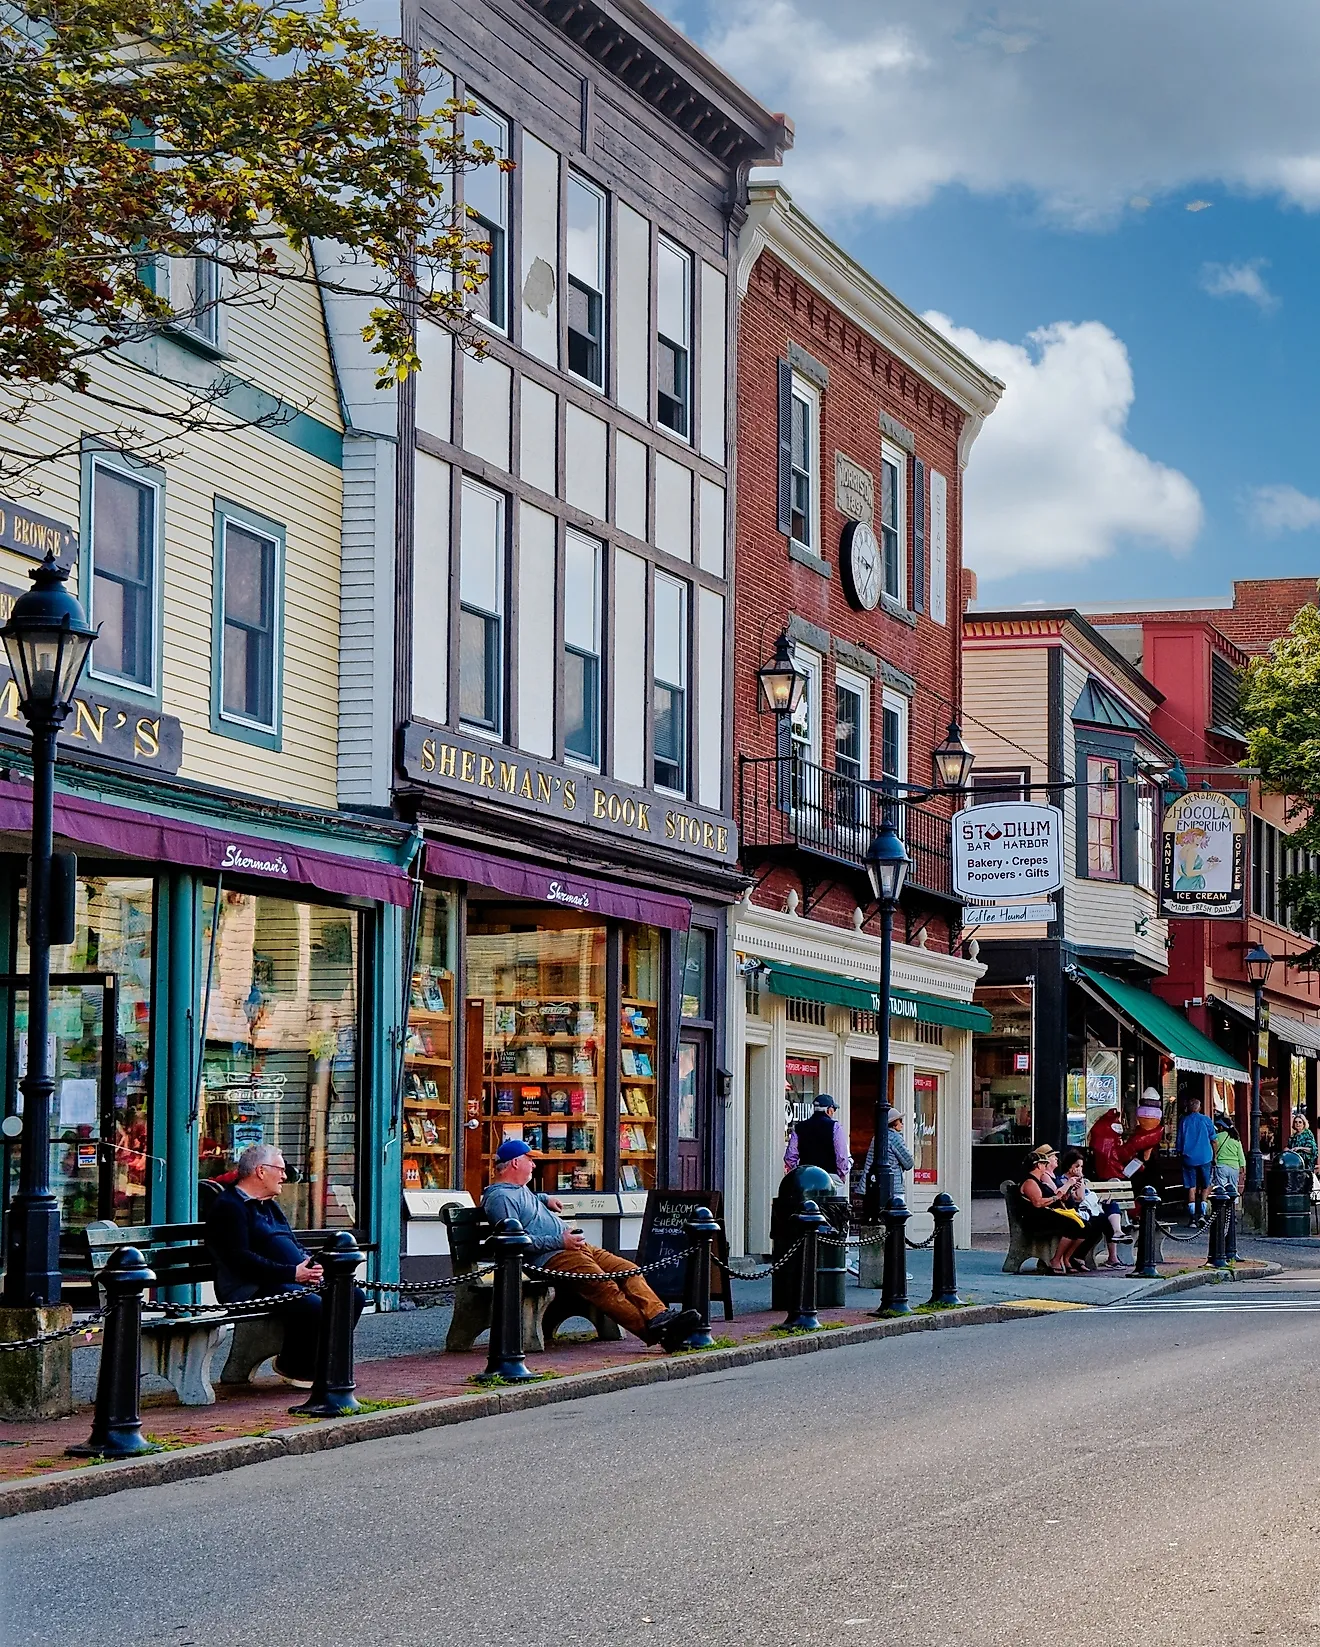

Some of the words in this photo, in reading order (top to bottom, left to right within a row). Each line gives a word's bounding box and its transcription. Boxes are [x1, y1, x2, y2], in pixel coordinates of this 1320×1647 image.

[0, 678, 160, 759] N'S
[420, 737, 577, 811] SHERMAN'S
[592, 786, 651, 832] BOOK
[665, 810, 729, 853] STORE
[1165, 806, 1248, 820] CHOCOLATE
[1177, 820, 1232, 832] EMPORIUM
[967, 842, 991, 852] BAR
[1003, 839, 1049, 850] HARBOR
[221, 845, 289, 875] Sherman's
[967, 858, 1002, 869] Bakery
[1012, 856, 1048, 867] Crepes
[967, 871, 1015, 882] Popovers
[1025, 868, 1050, 878] Gifts
[546, 881, 590, 908] Sherman's
[1176, 892, 1191, 900] ICE
[1195, 892, 1227, 900] CREAM
[1171, 902, 1190, 912] MADE
[1192, 903, 1212, 912] FRESH
[1214, 904, 1233, 913] DAILY
[966, 909, 996, 922] Coffee
[888, 997, 918, 1018] TADIUM
[653, 1217, 688, 1228] SHERMA
